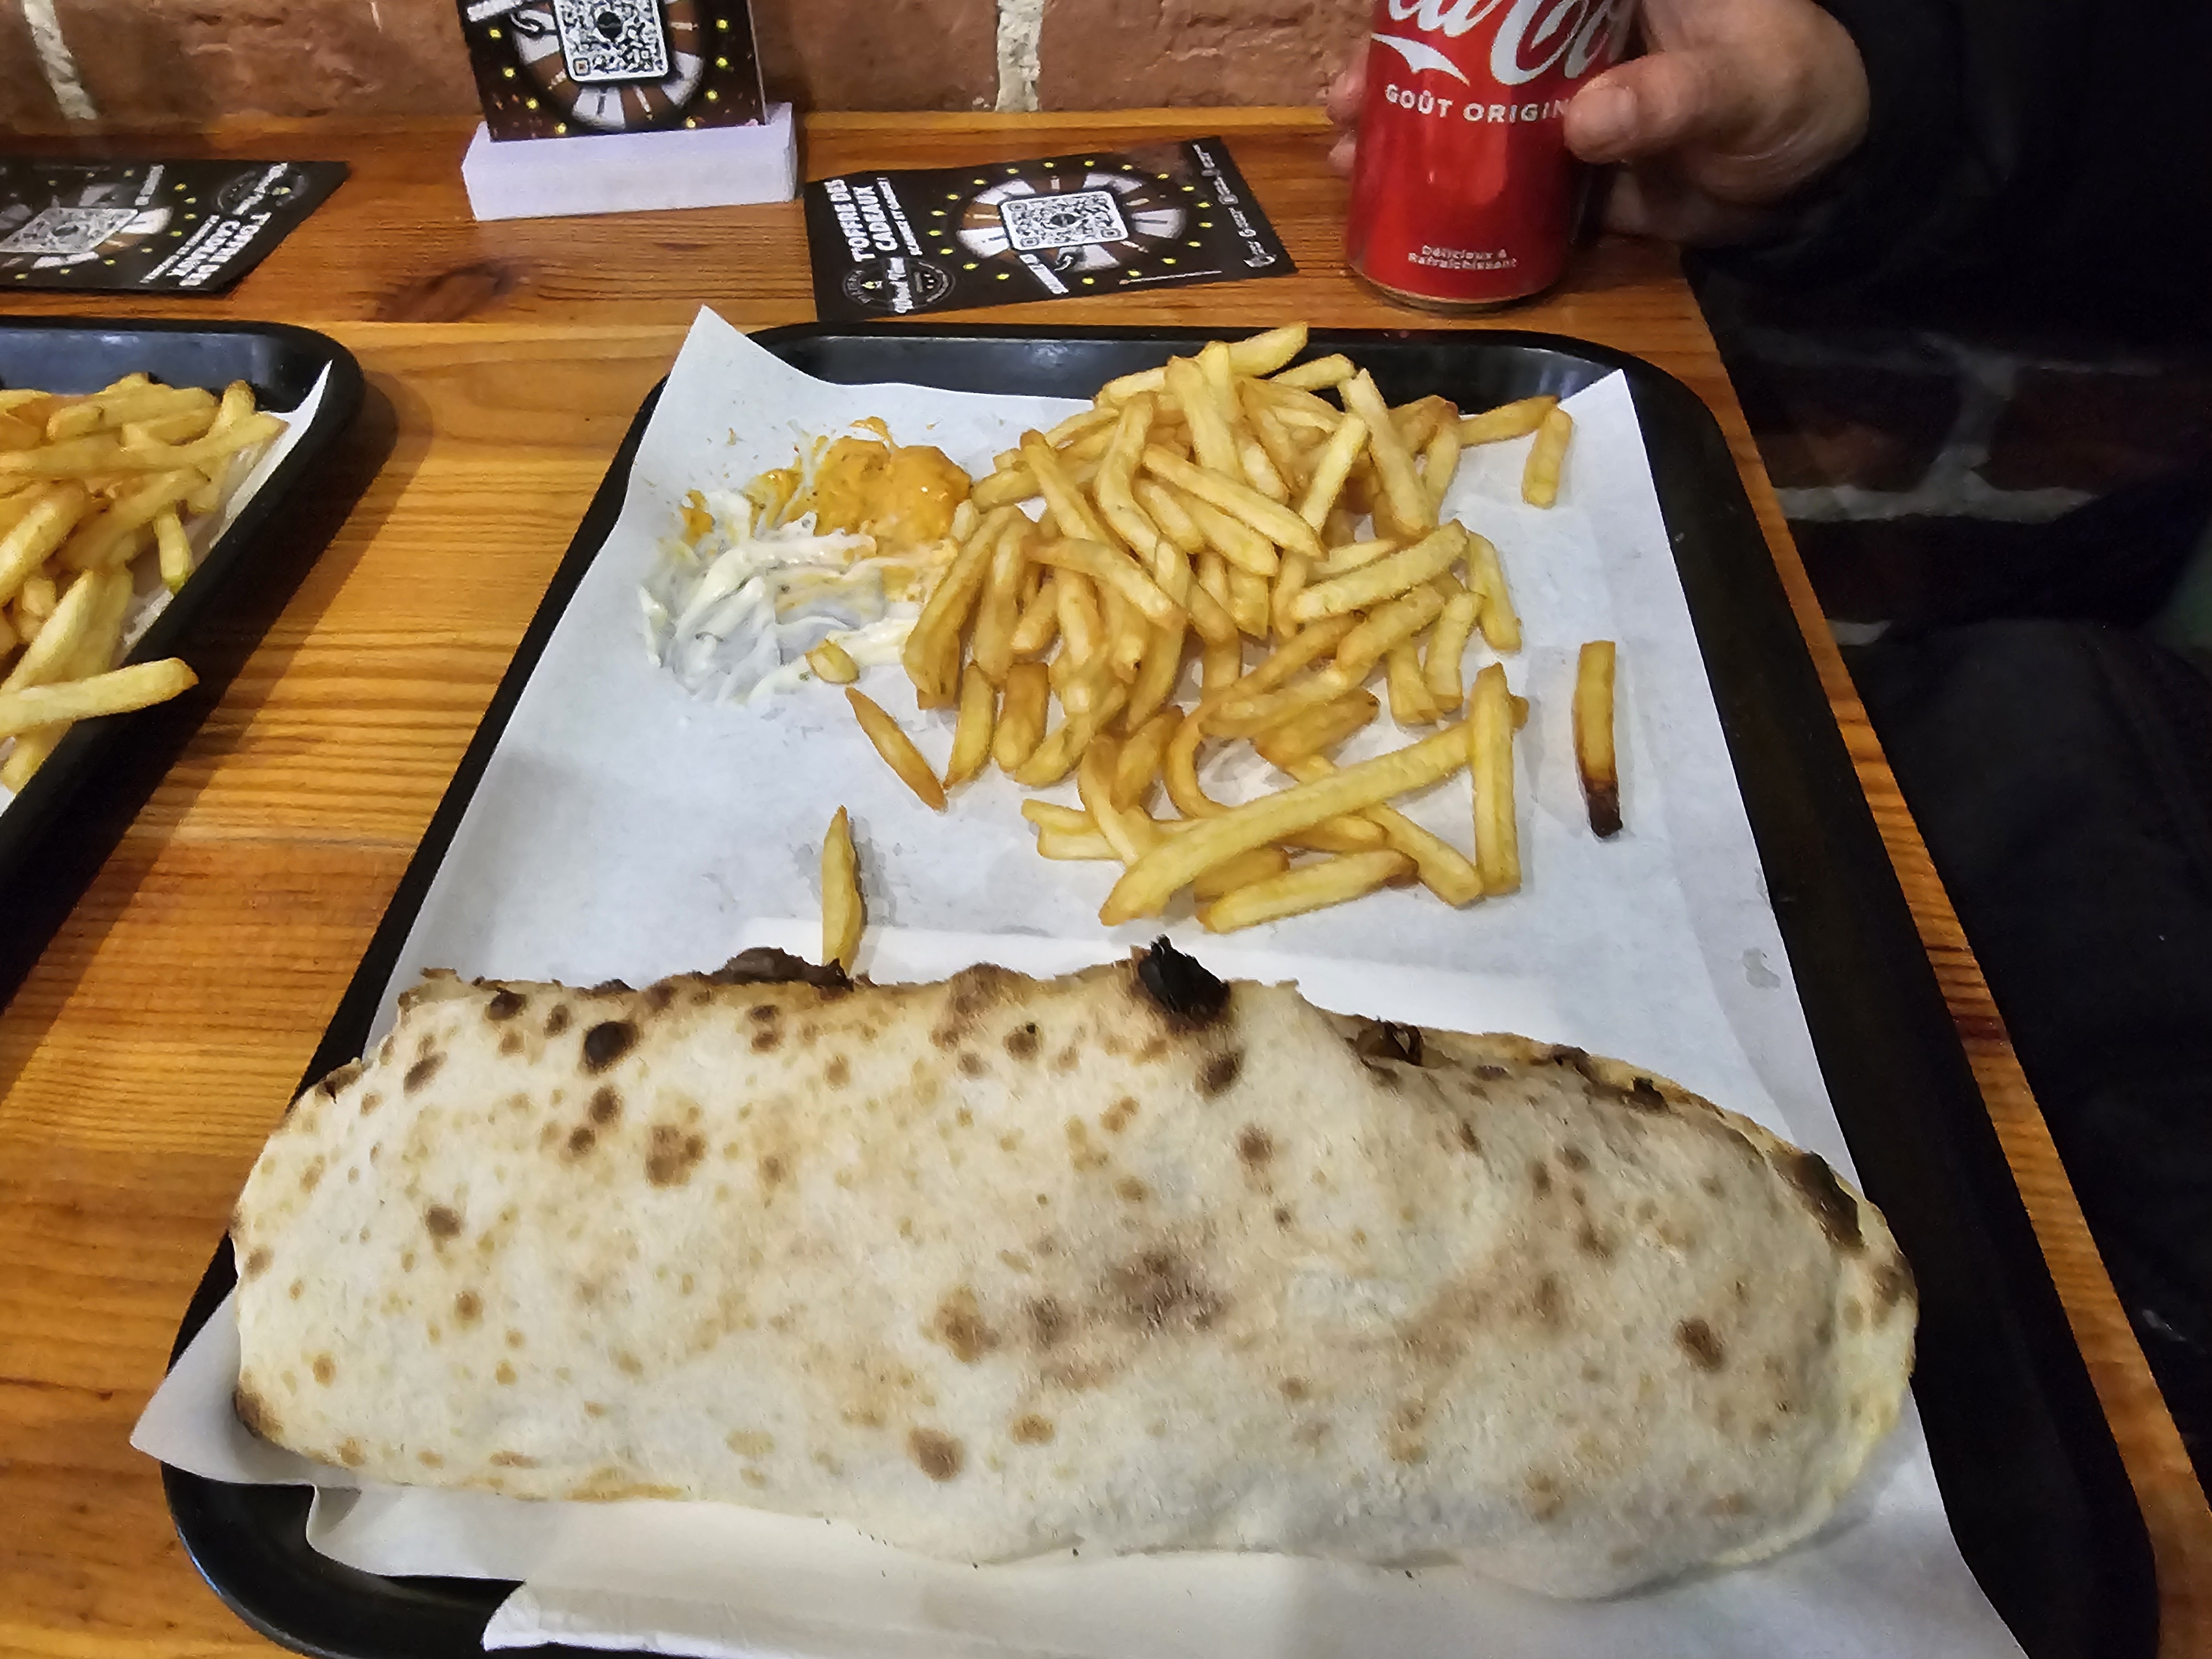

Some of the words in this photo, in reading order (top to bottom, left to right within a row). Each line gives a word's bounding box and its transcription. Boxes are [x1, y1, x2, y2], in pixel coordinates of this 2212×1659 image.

[1385, 84, 1453, 118] GOÛT
[1463, 98, 1570, 123] ORIGIN
[852, 185, 898, 251] CADEAUX
